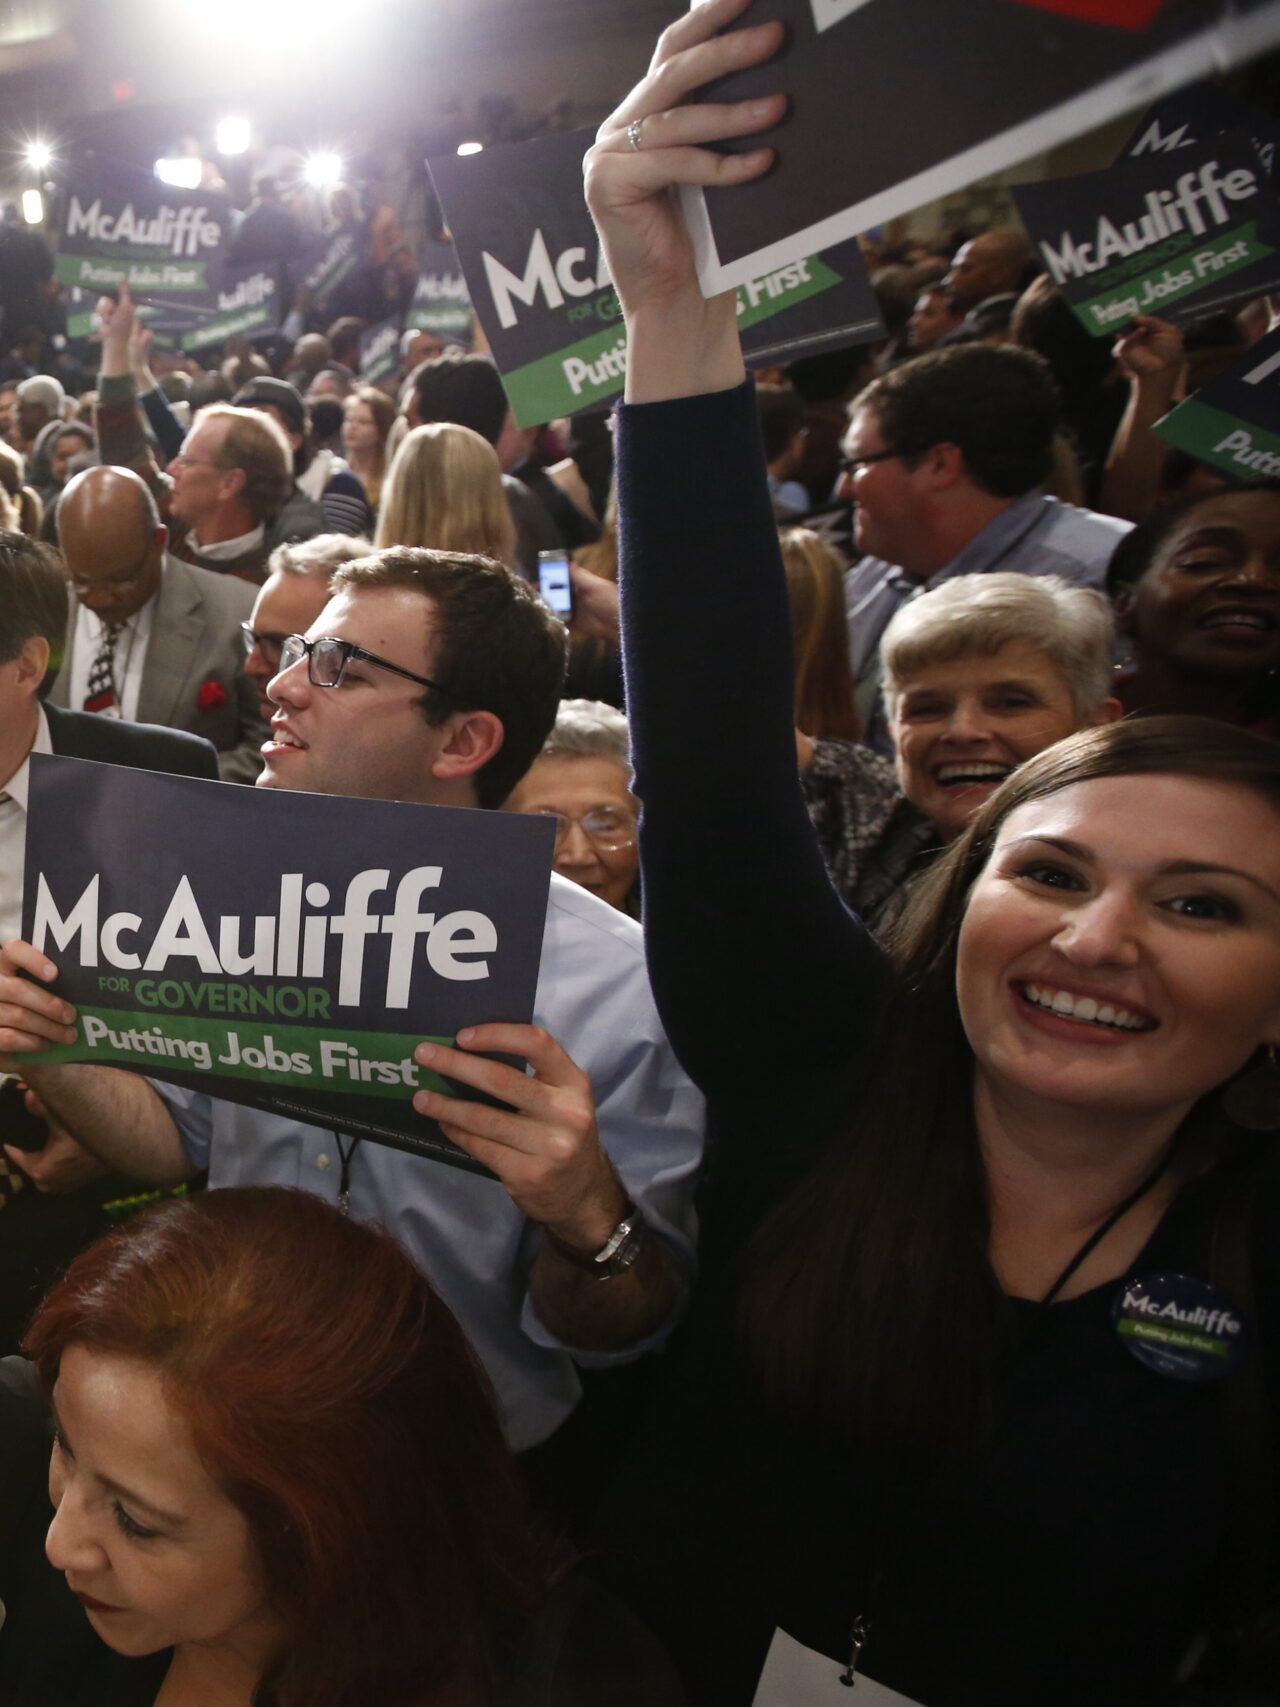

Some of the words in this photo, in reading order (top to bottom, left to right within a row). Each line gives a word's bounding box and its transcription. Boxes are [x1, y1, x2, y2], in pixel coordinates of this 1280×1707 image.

[66, 196, 221, 255] McAuliffe
[1039, 160, 1259, 286] McAuliffe
[744, 259, 812, 308] First
[1140, 270, 1195, 307] Jobs
[1192, 240, 1251, 278] First
[562, 338, 626, 395] Putti
[1212, 428, 1280, 479] Putt
[31, 866, 498, 1009] McAuliffe
[98, 976, 130, 992] FOR
[134, 979, 332, 1020] GOVERNOR
[81, 1015, 213, 1070] Putting
[218, 1032, 313, 1075] Jobs
[320, 1040, 420, 1087] First
[1122, 1291, 1240, 1335] McAuliffe
